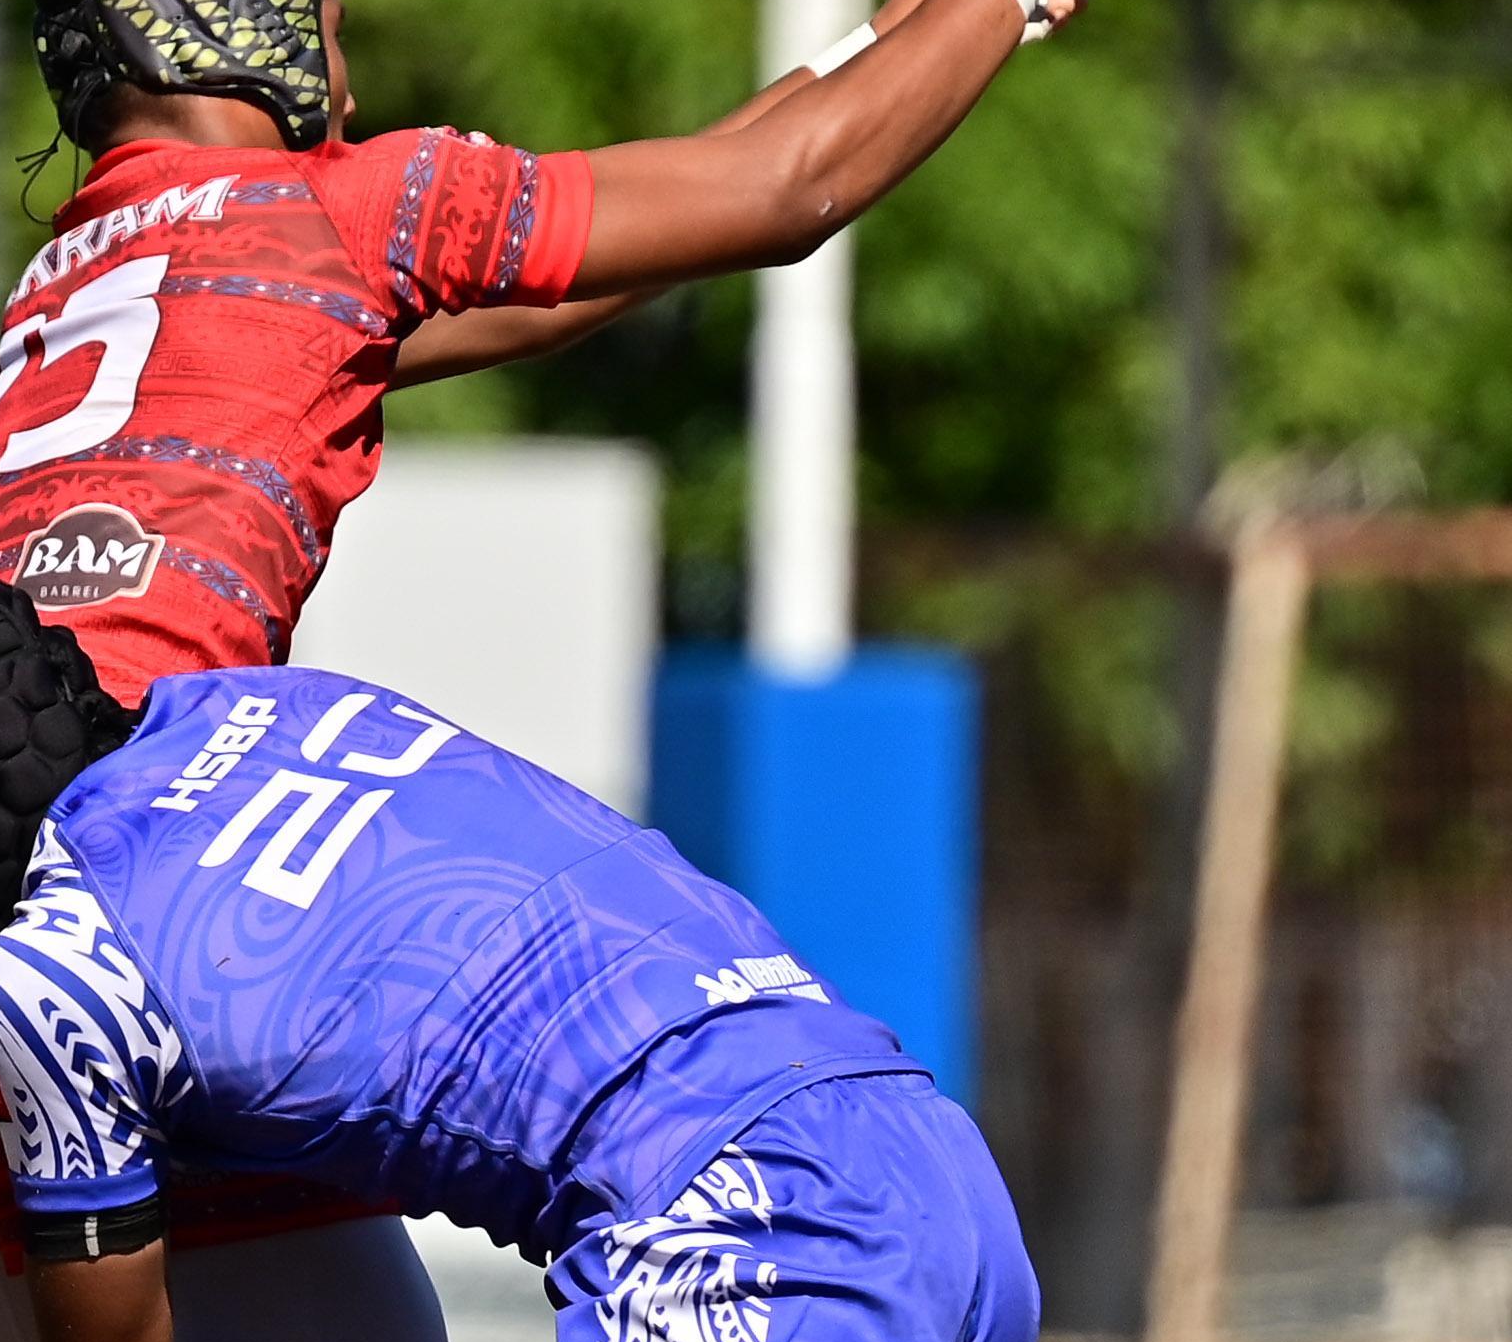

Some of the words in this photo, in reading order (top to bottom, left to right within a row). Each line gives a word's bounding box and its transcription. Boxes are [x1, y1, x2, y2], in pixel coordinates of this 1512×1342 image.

[22, 534, 150, 579] BAM
[39, 585, 101, 600] BARREL
[150, 691, 280, 813] HSBP
[197, 691, 462, 910] 20
